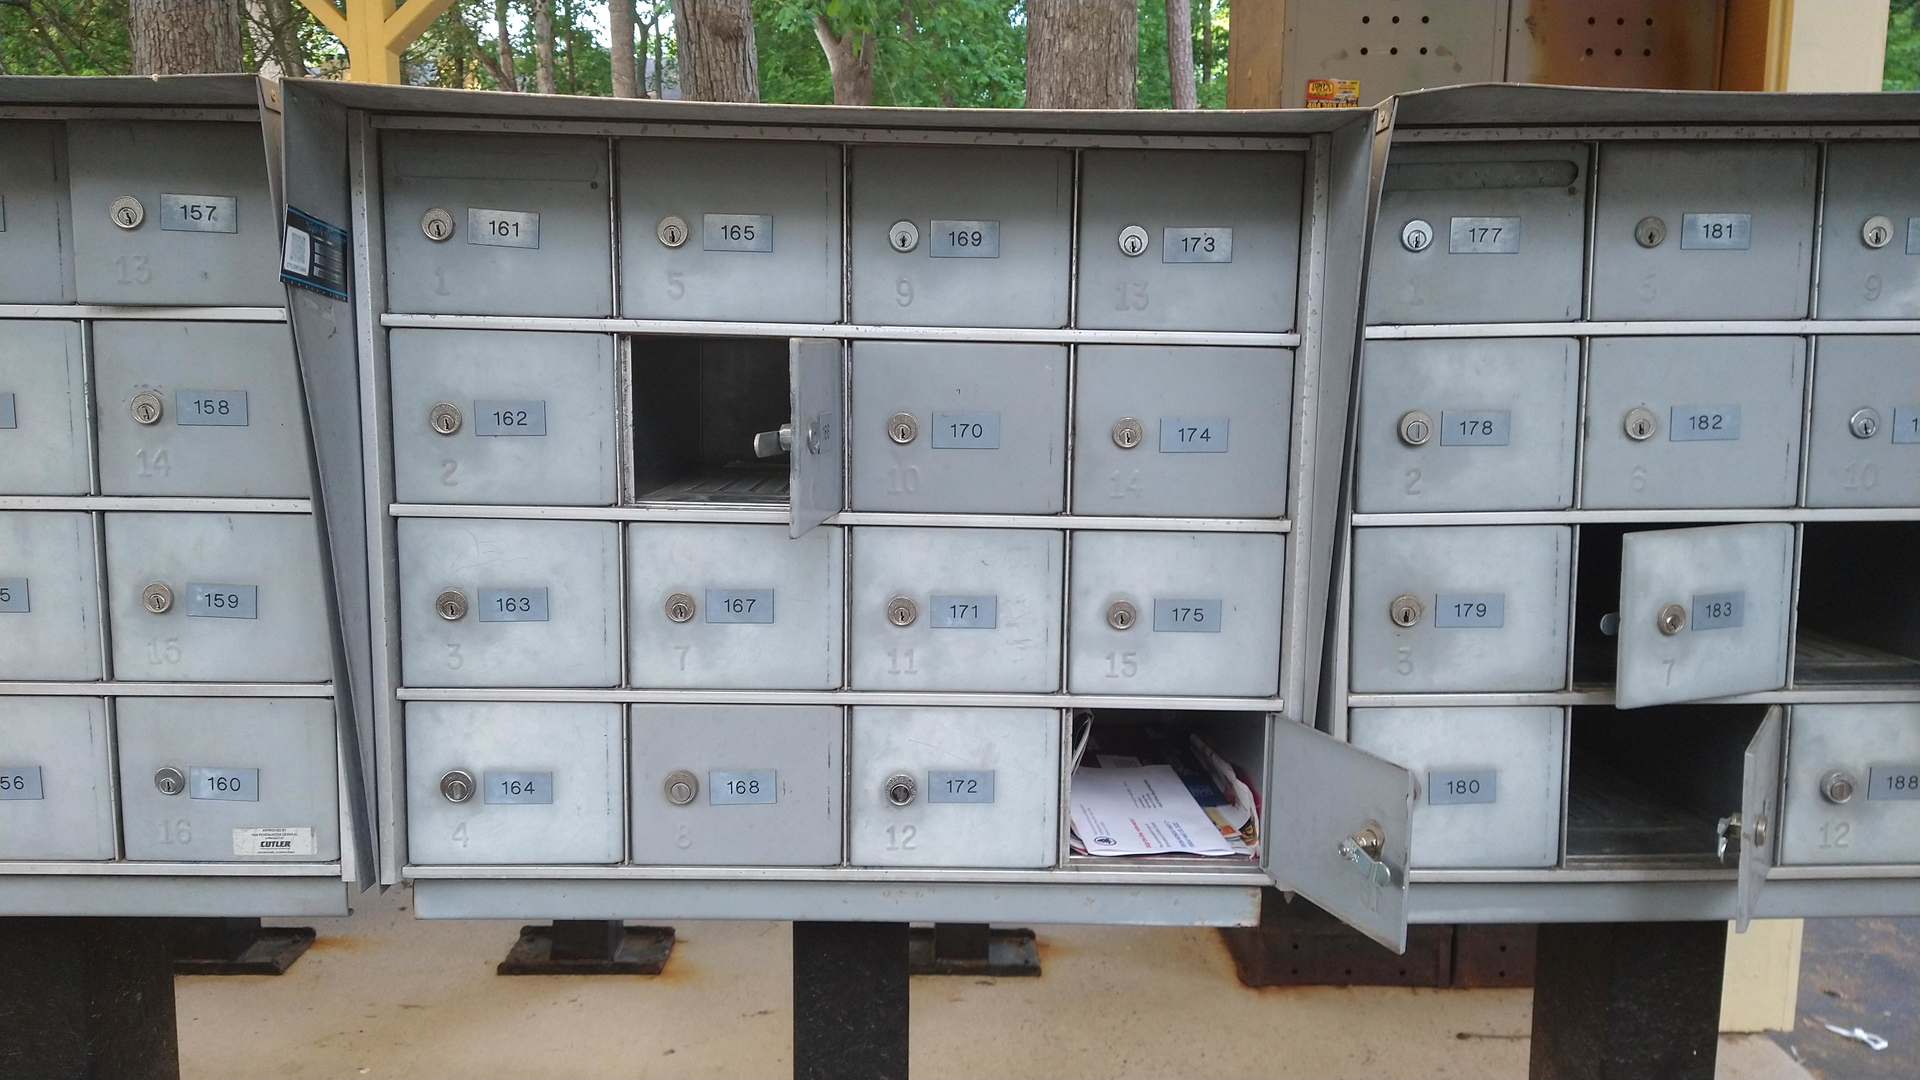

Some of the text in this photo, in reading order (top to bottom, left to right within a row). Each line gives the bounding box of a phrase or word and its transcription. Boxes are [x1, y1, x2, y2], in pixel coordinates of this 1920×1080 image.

[180, 204, 217, 222] 157
[488, 220, 519, 237] 161
[721, 224, 755, 241] 165
[1468, 227, 1503, 243] 177
[1702, 223, 1733, 239] 181
[948, 230, 982, 247] 169
[1181, 236, 1215, 253] 173
[115, 255, 152, 284] 13
[435, 266, 451, 296] 1
[667, 272, 684, 301] 5
[1639, 275, 1657, 302] 5
[1863, 274, 1882, 301] 9
[896, 278, 915, 308] 9
[1114, 280, 1149, 312] 13
[1408, 277, 1424, 307] 1
[193, 399, 230, 415] 158
[493, 410, 528, 426] 162
[1689, 414, 1723, 431] 182
[950, 423, 983, 439] 170
[1178, 427, 1212, 443] 174
[1459, 420, 1493, 436] 178
[136, 449, 171, 478] 14
[441, 460, 459, 486] 2
[887, 466, 919, 495] 10
[1405, 469, 1422, 495] 2
[1631, 466, 1647, 491] 6
[1844, 463, 1878, 490] 10
[1110, 471, 1143, 499] 14
[204, 593, 239, 609] 159
[496, 597, 531, 612] 163
[723, 598, 757, 613] 167
[1454, 602, 1487, 618] 179
[1705, 601, 1732, 619] 183
[949, 604, 978, 619] 171
[1172, 607, 1204, 623] 175
[148, 638, 181, 665] 15
[447, 644, 463, 670] 3
[674, 646, 690, 671] 7
[887, 648, 918, 675] 11
[1105, 653, 1138, 678] 15
[1398, 648, 1414, 675] 3
[1662, 660, 1675, 685] 7
[207, 776, 241, 792] 160
[501, 780, 536, 795] 164
[726, 780, 760, 795] 168
[946, 779, 978, 794] 172
[1447, 779, 1480, 795] 180
[1887, 775, 1919, 790] 188
[157, 819, 191, 845] 16
[452, 823, 469, 847] 4
[886, 826, 917, 851] 12
[1819, 823, 1849, 849] 12
[260, 840, 291, 848] CUTLER
